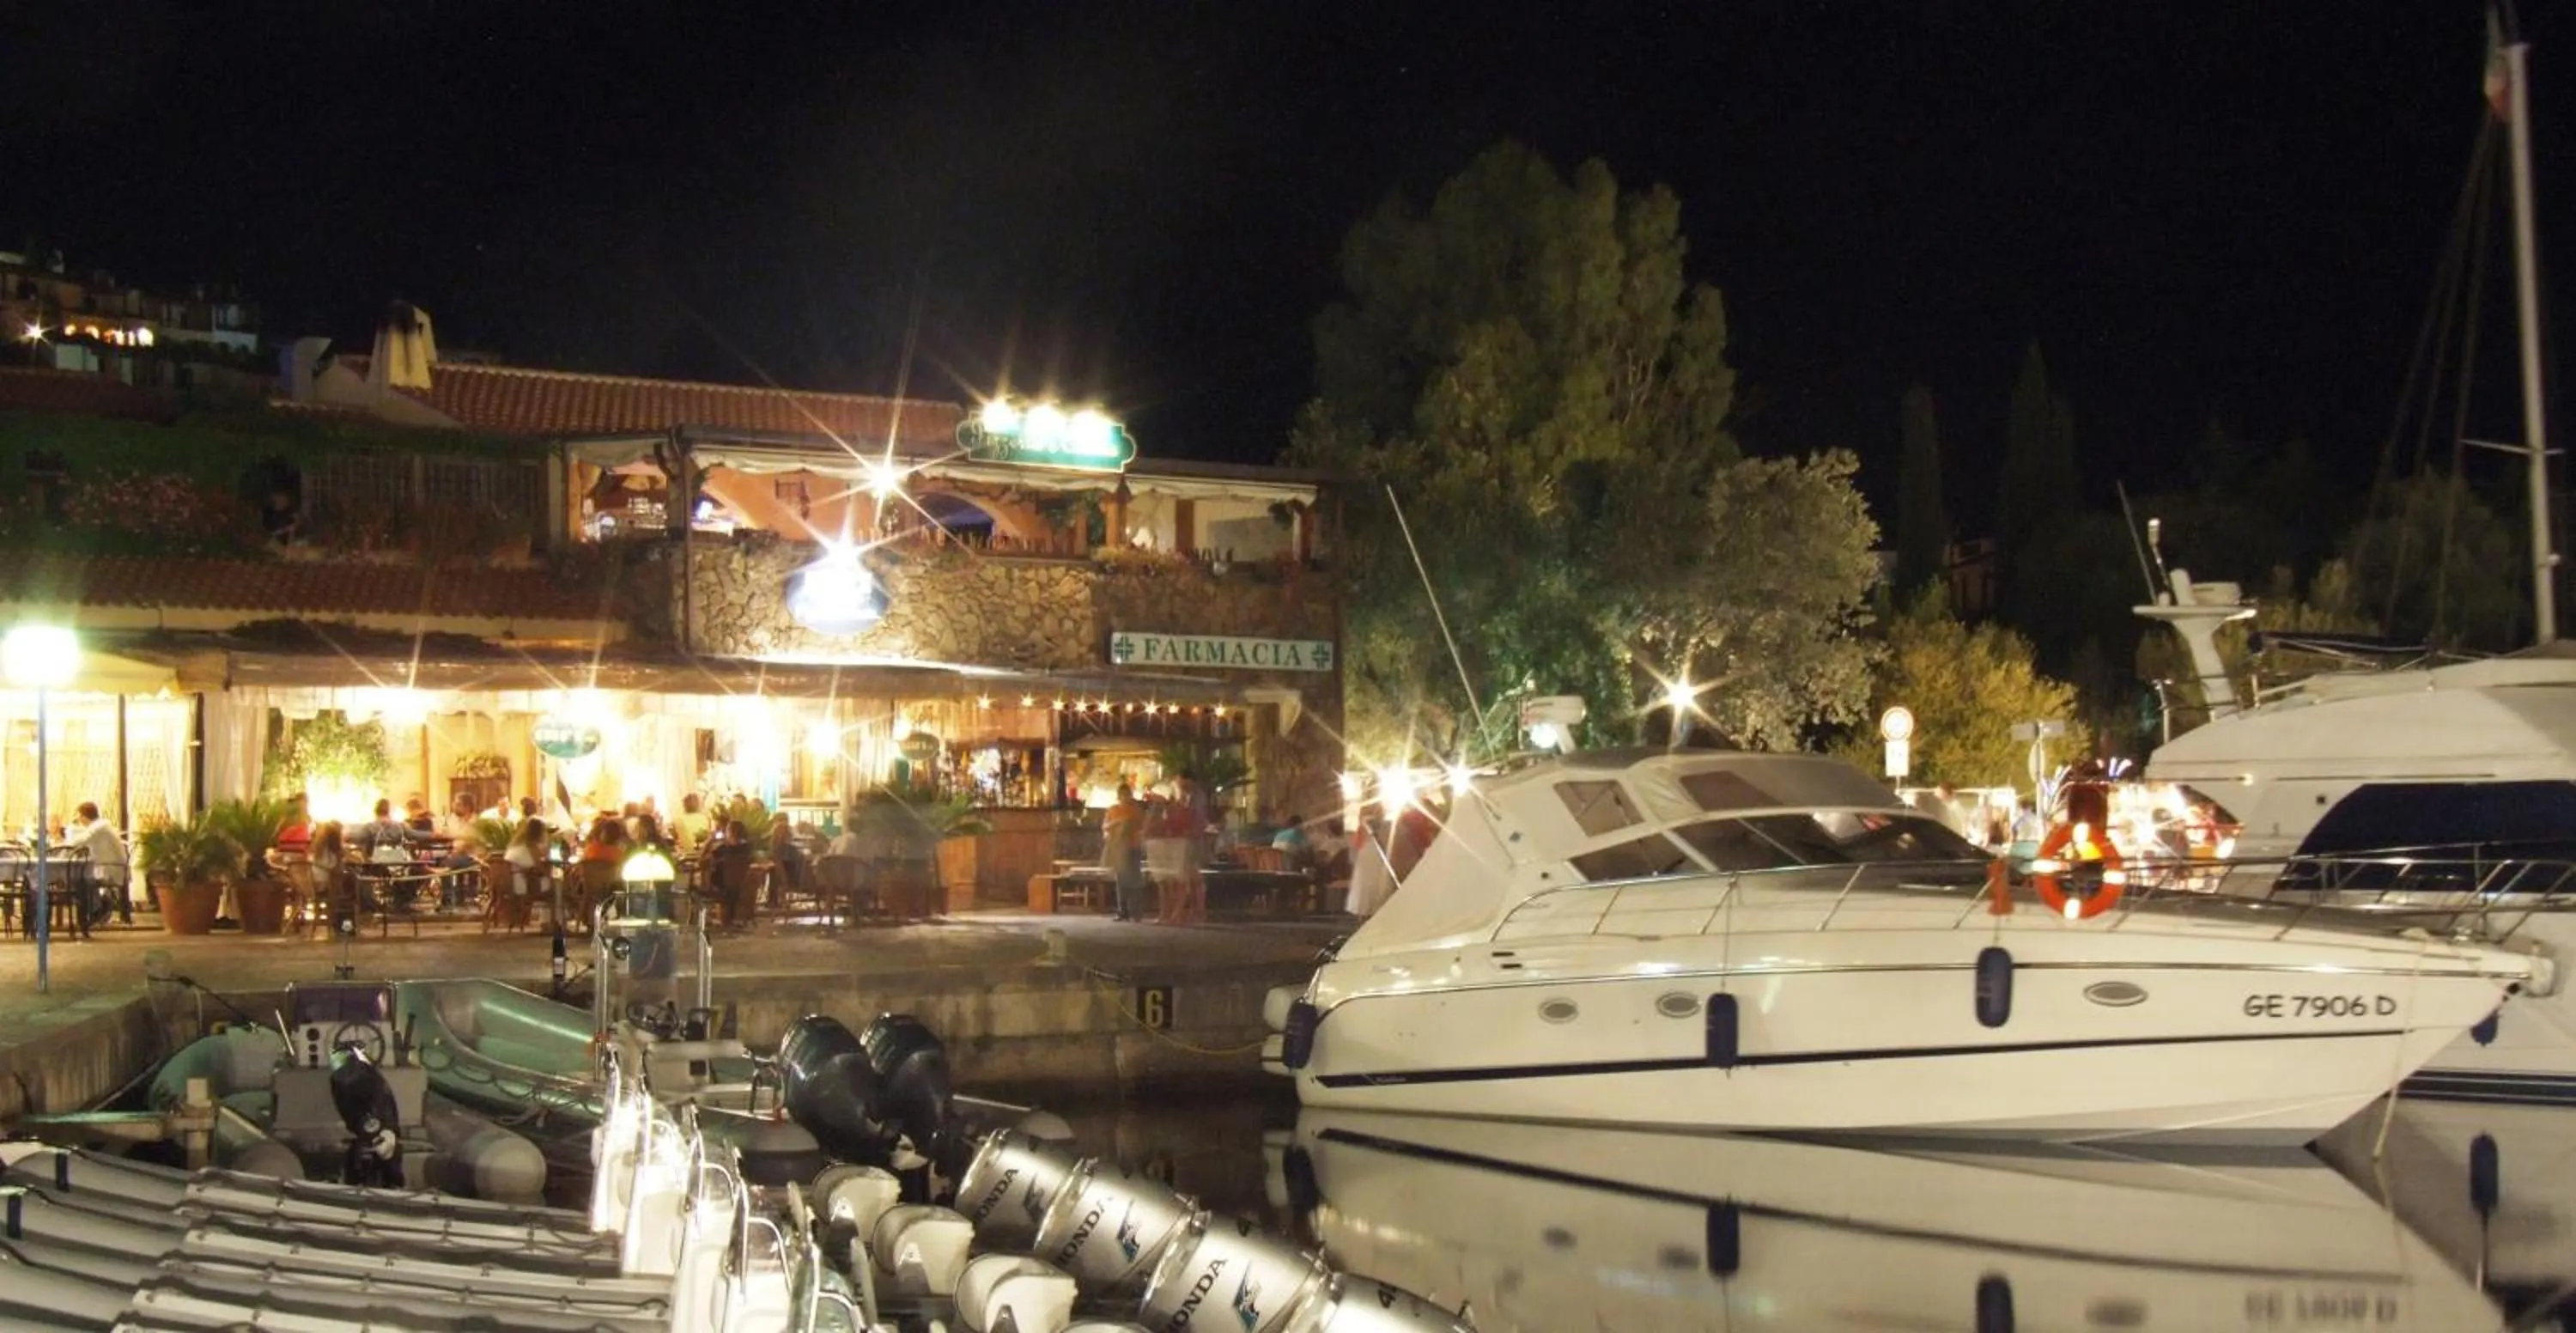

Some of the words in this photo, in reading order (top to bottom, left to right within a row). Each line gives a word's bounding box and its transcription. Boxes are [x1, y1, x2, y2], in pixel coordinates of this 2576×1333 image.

[1145, 637, 1303, 666] FARMACIA
[1145, 989, 1163, 1028] 6
[2243, 994, 2285, 1018] GE
[2291, 995, 2367, 1018] 7906
[2376, 994, 2399, 1016] D
